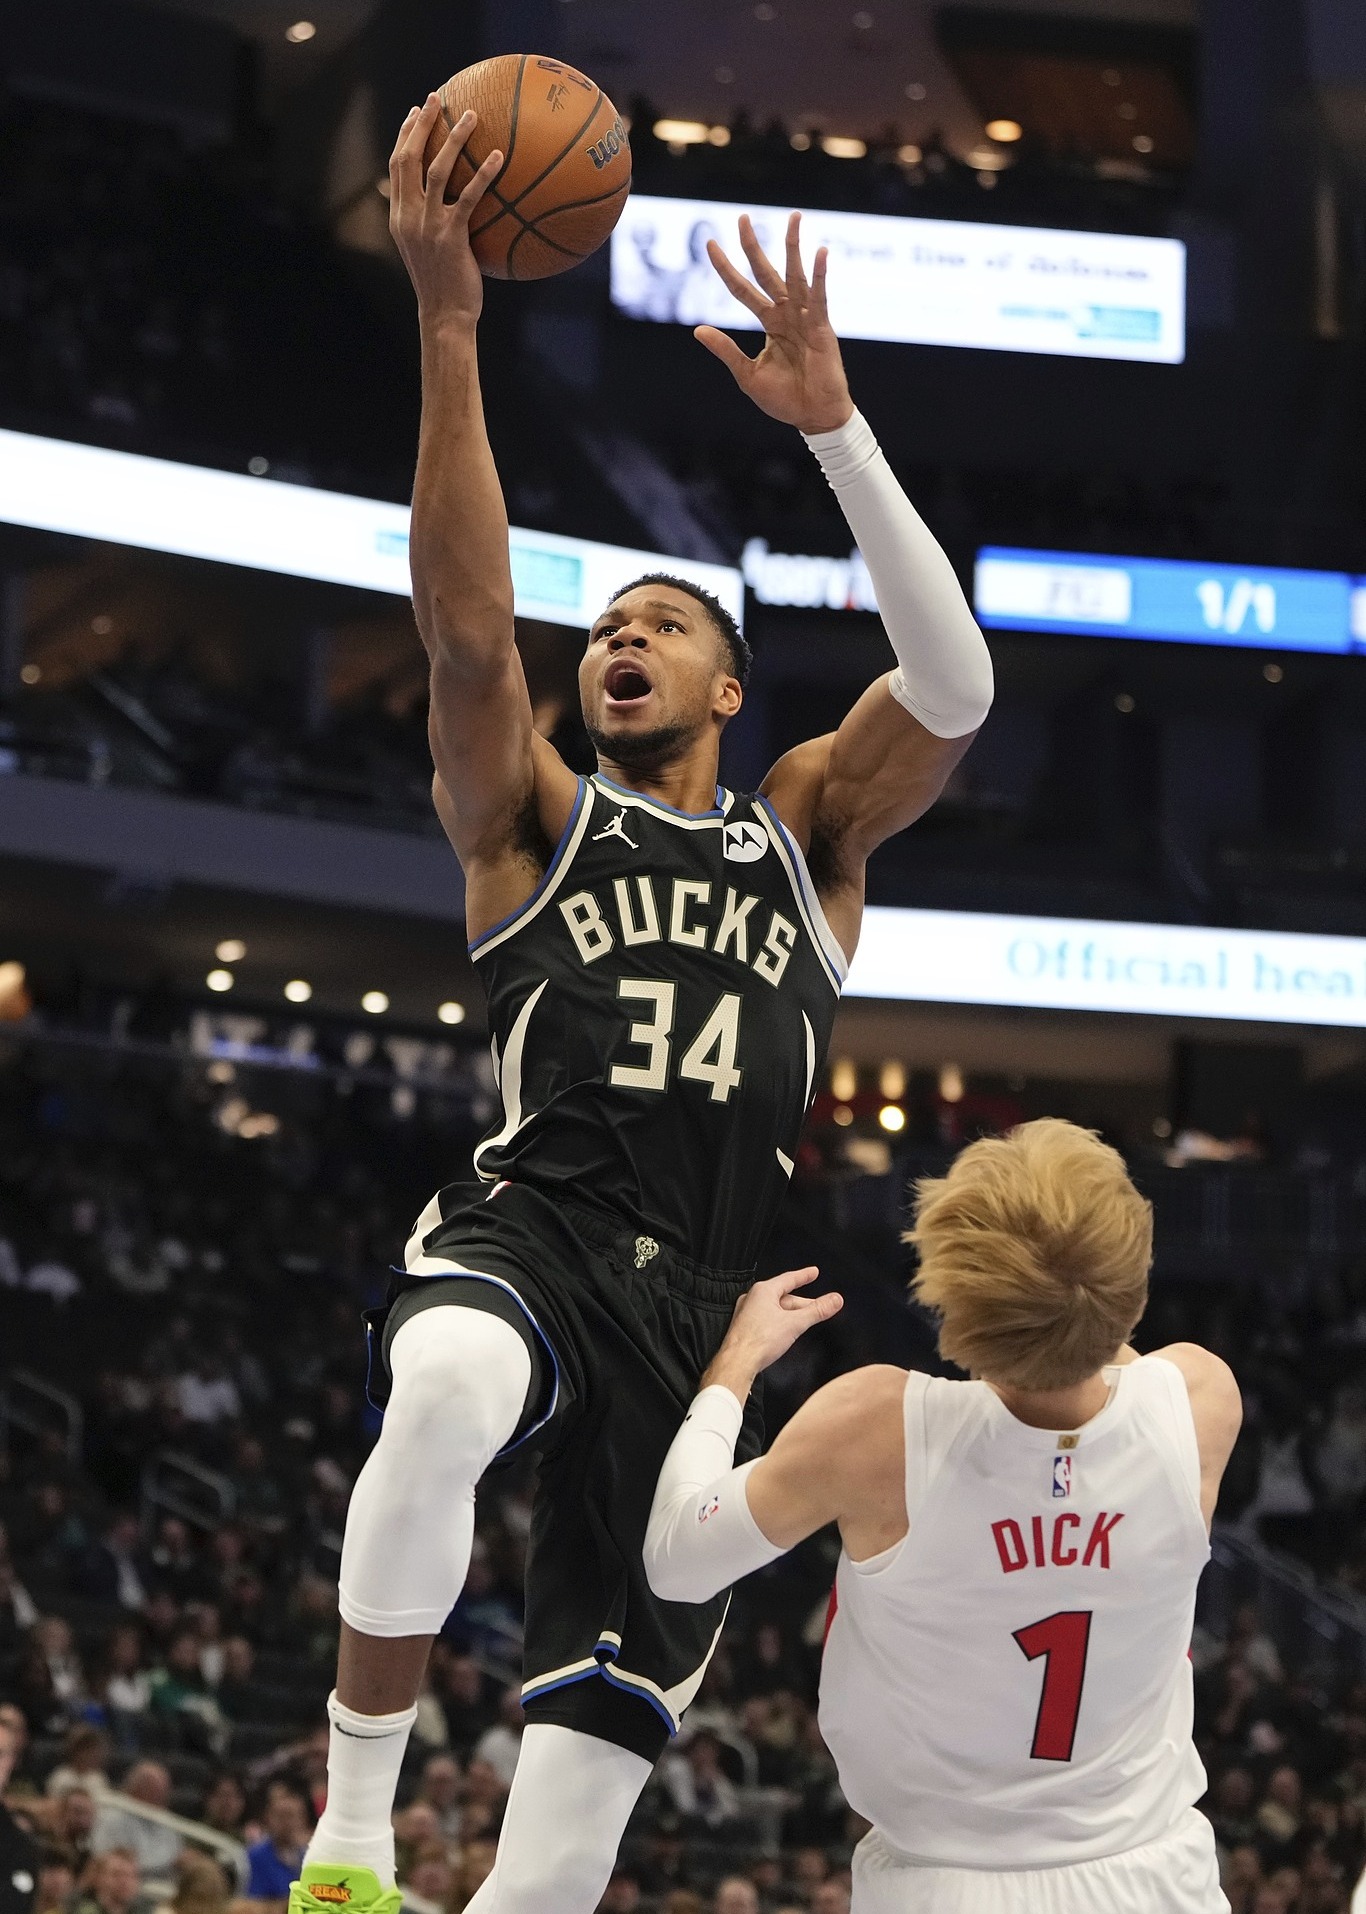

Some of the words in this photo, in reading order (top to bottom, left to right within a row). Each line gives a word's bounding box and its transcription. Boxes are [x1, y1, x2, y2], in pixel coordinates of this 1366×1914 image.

[556, 874, 798, 990] BUCKS
[1007, 937, 1229, 990] Official
[608, 976, 745, 1106] 34
[991, 1512, 1125, 1573] DICK
[1011, 1610, 1093, 1762] 1
